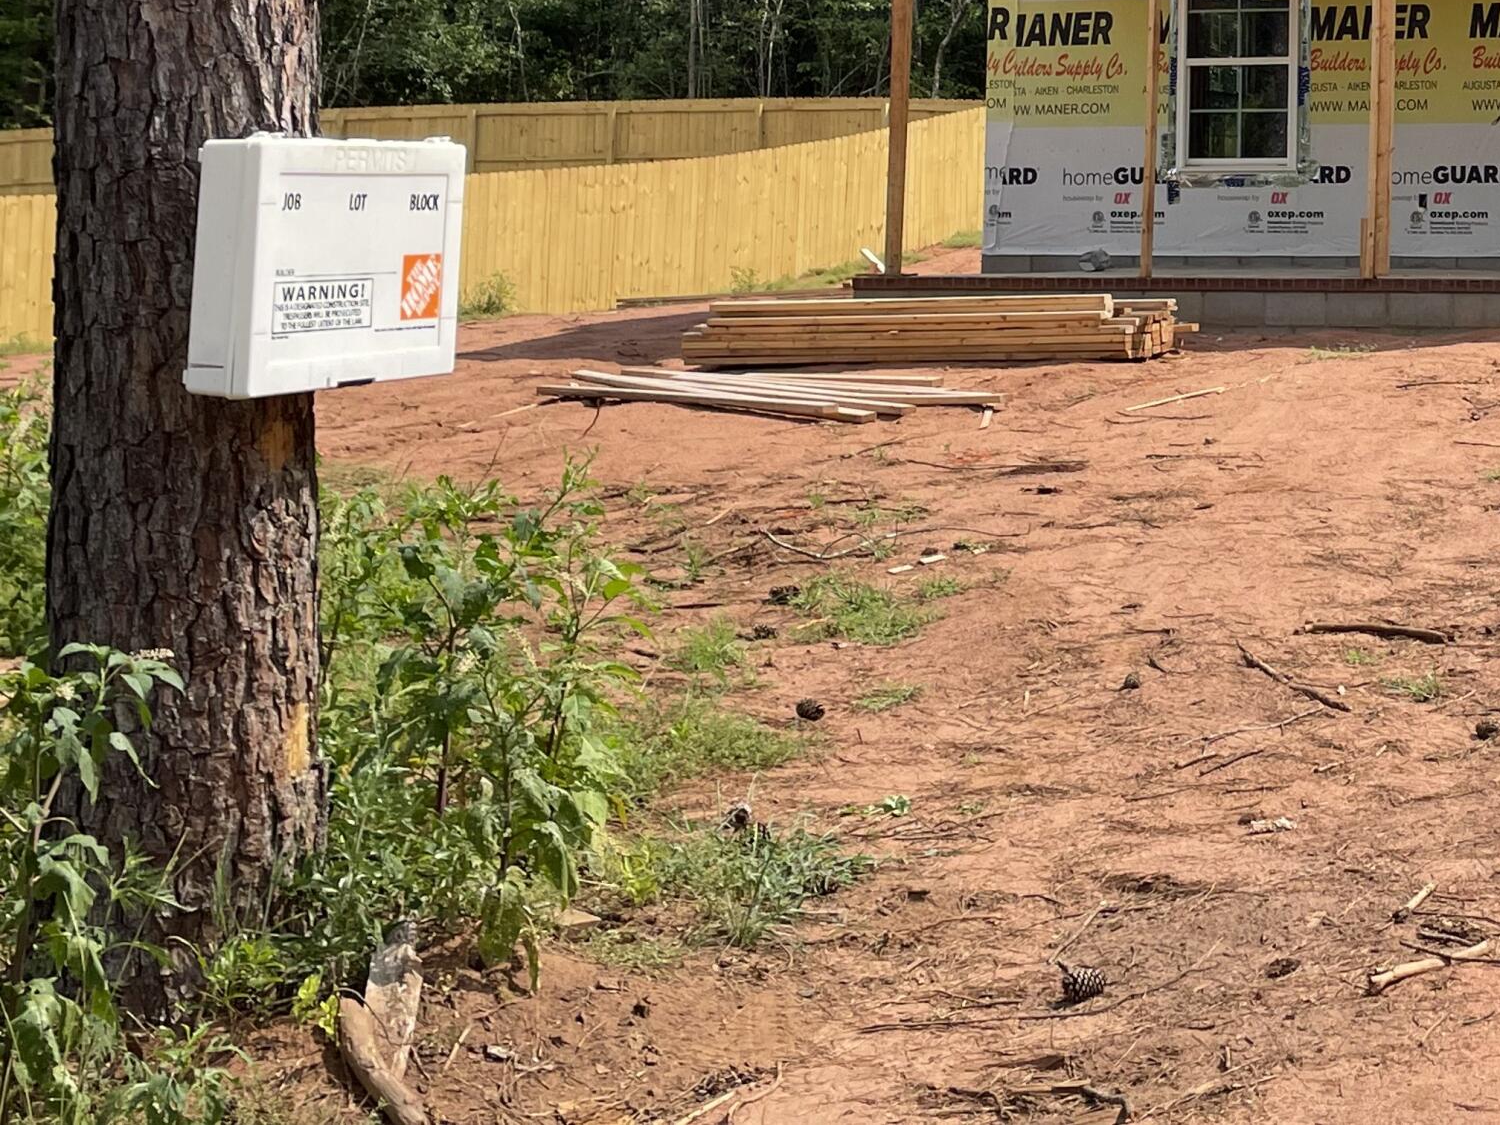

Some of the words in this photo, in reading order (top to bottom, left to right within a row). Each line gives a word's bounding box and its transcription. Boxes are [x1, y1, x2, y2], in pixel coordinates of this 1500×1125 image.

[1056, 53, 1103, 81] Supply
[1106, 52, 1128, 79] Co.
[1311, 48, 1366, 72] Builders
[1424, 47, 1447, 75] Co.
[1035, 86, 1058, 95] AIKEN
[1067, 84, 1119, 95] CHARLESTON
[1311, 82, 1338, 93] GUSTA
[1035, 103, 1110, 116] MANER.COM
[1348, 98, 1428, 112] MA.COM
[282, 193, 302, 212] JOB
[349, 193, 368, 212] LOT
[409, 194, 440, 212] BLOCK
[1114, 192, 1132, 205] OX
[1271, 192, 1288, 205] OX
[1434, 192, 1452, 205] OX
[1268, 209, 1324, 221] oxep.com
[1430, 209, 1488, 221] oxep.com
[282, 283, 366, 302] WARNING!
